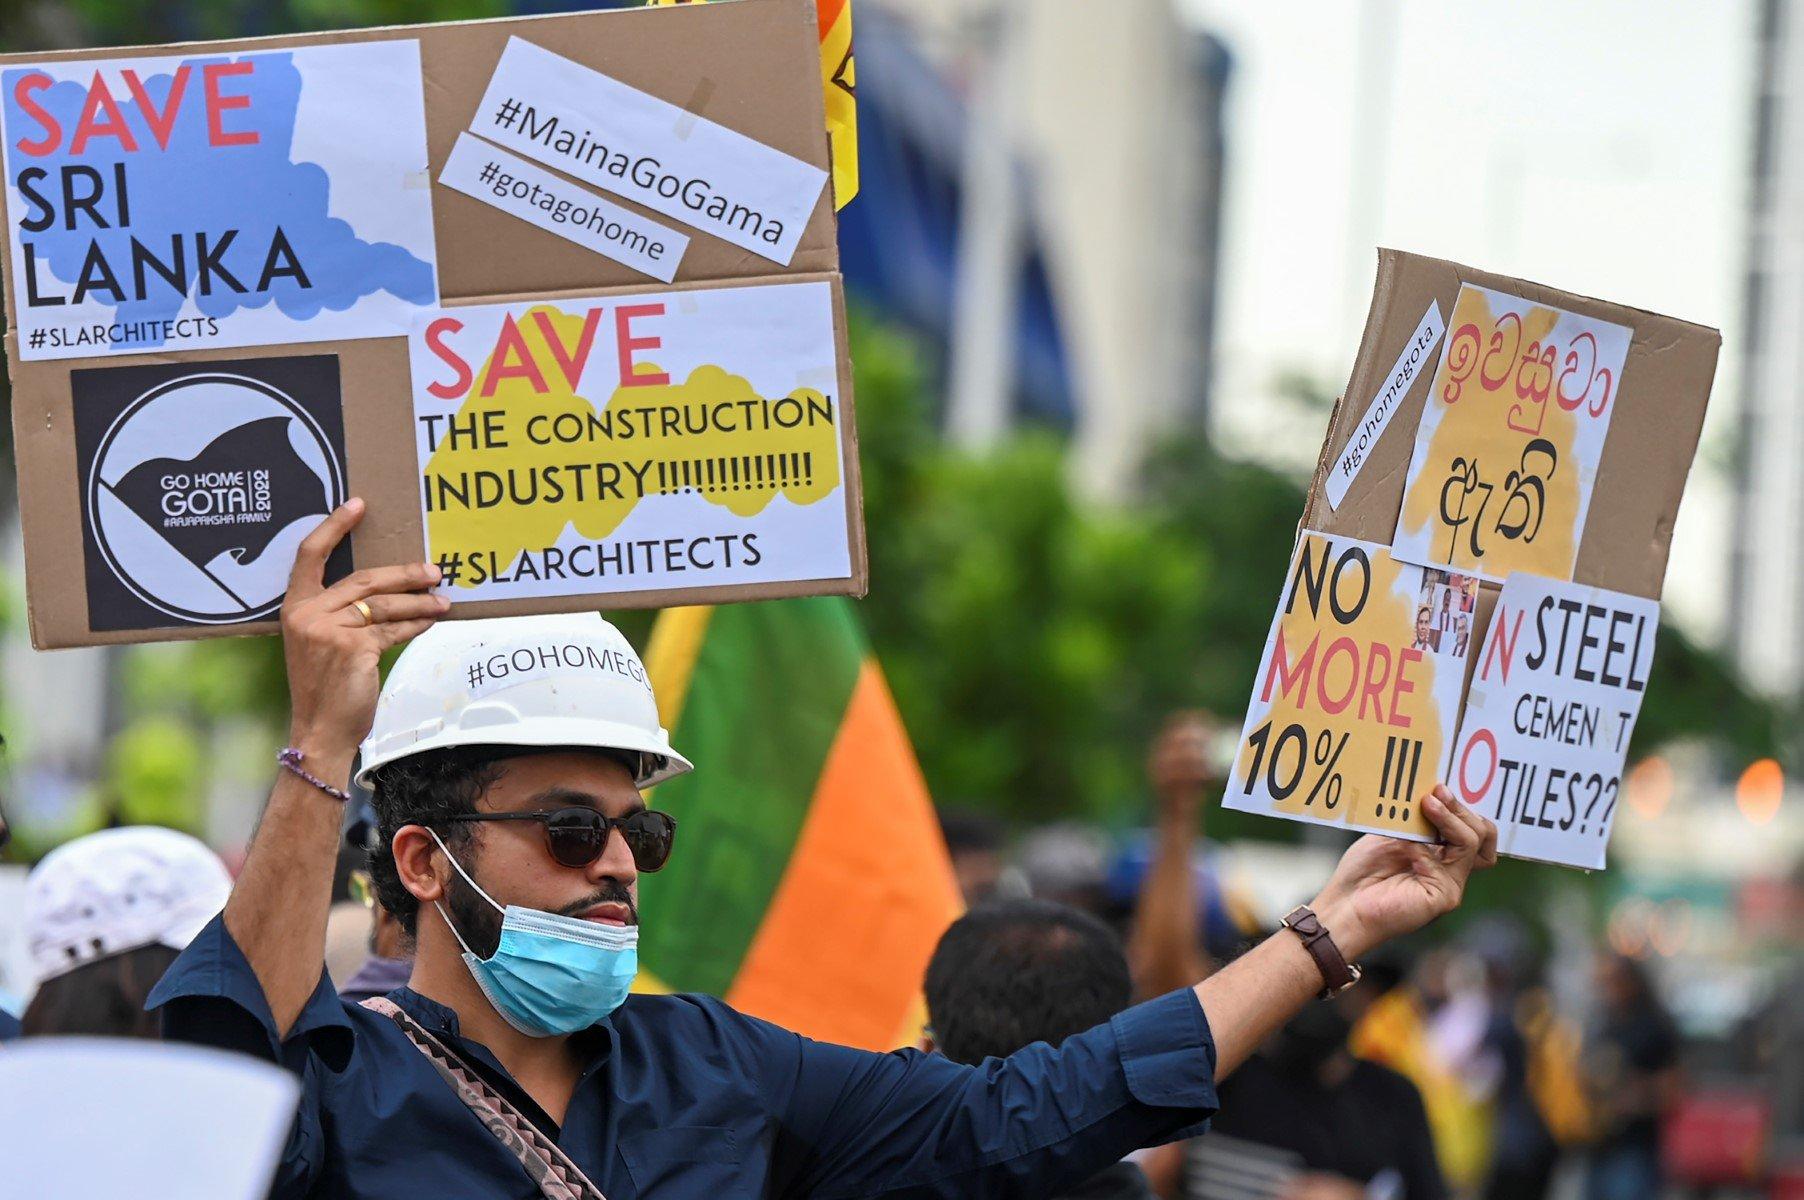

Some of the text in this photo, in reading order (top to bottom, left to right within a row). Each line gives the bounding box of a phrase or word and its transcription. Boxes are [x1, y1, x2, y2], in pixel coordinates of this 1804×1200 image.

[14, 62, 260, 157] SAVE
[17, 162, 130, 232] SRI
[478, 161, 665, 261] #gotagohome
[494, 97, 785, 245] #MainaGoGama
[23, 225, 312, 307] LANKA
[29, 317, 219, 349] #SLARCHITECTS
[424, 303, 670, 400] SAVE
[1443, 312, 1611, 436] ඉවසුවා
[419, 395, 834, 453] THE CONSTRUCTION
[1342, 326, 1434, 477] #gohomegota
[160, 472, 244, 490] GO HOME
[161, 487, 247, 517] GOTA
[236, 512, 272, 524] FAMILY
[253, 469, 271, 511] 2022
[1440, 438, 1557, 565] ඇති
[434, 533, 762, 587] #SLARCHITECTS
[1285, 536, 1371, 625] NO
[1260, 624, 1423, 728] MORE
[1481, 595, 1647, 692] N STEEL
[1243, 720, 1423, 821] 10% !!!
[1459, 728, 1619, 837] O TILES??
